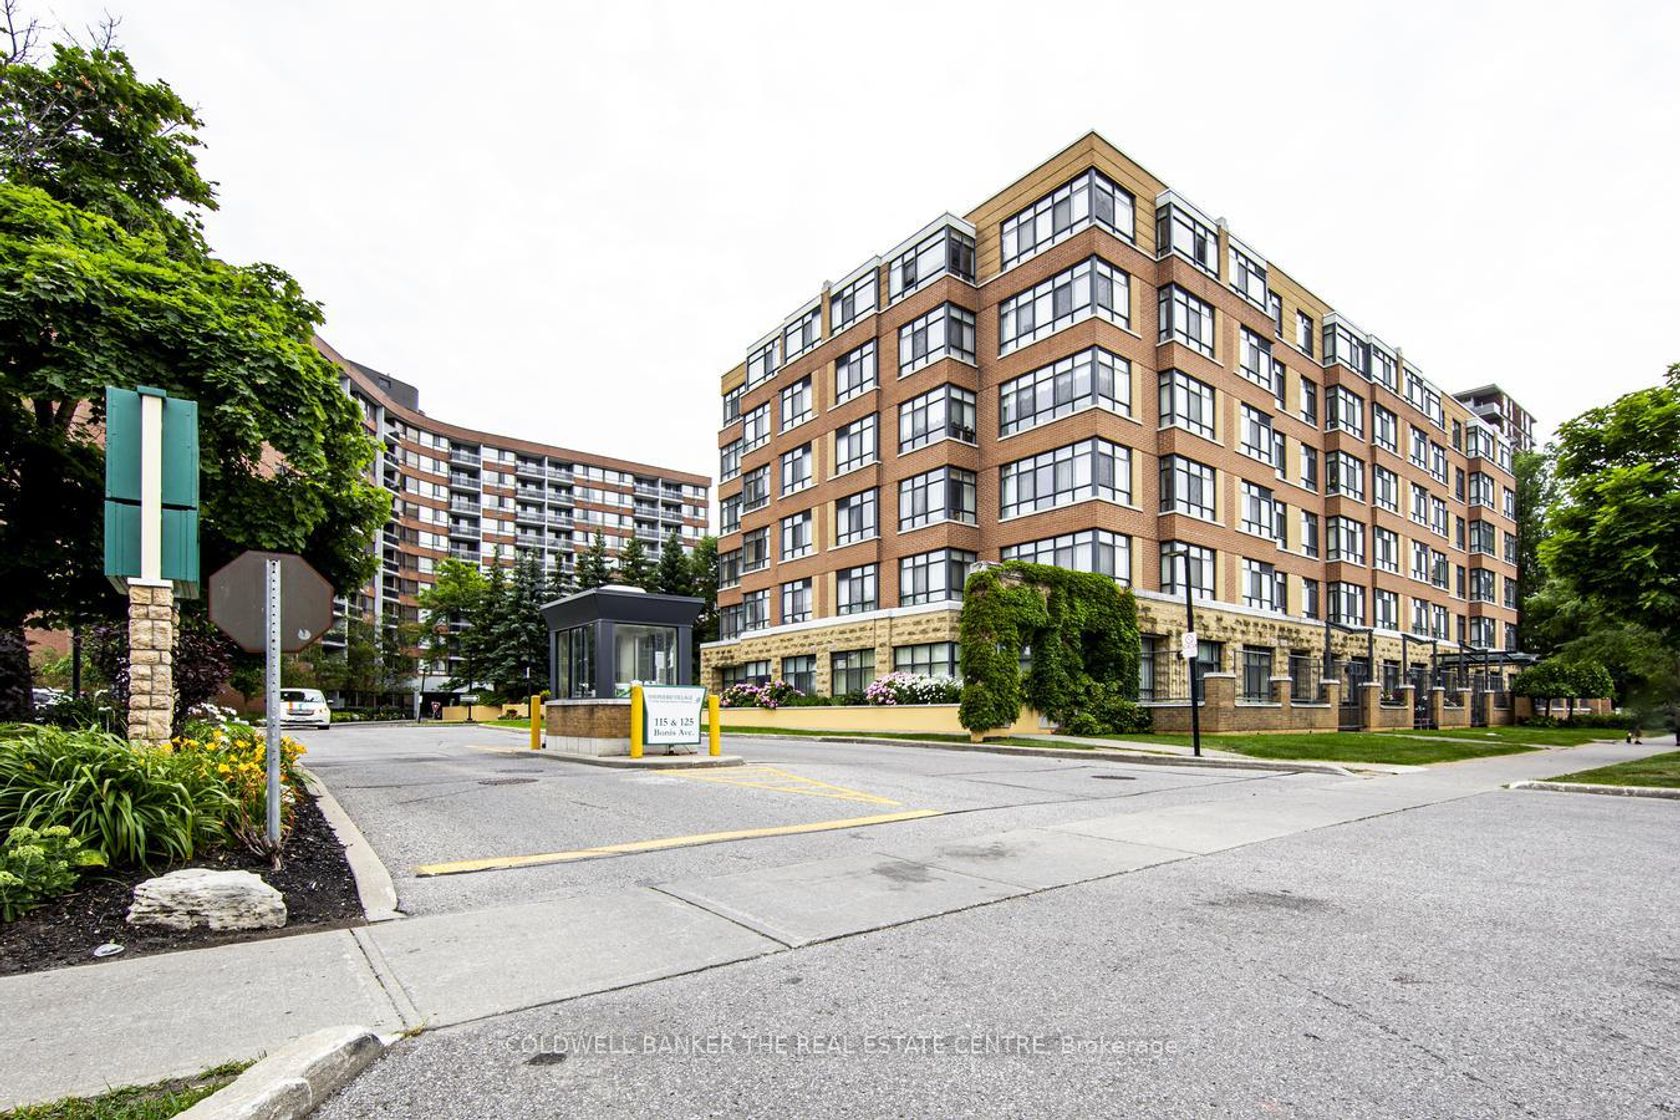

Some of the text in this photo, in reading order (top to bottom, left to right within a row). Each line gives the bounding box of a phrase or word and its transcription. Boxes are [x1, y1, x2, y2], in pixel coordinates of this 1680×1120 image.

[655, 717, 694, 727] 115 & 125
[654, 729, 695, 737] Bonis Ave.
